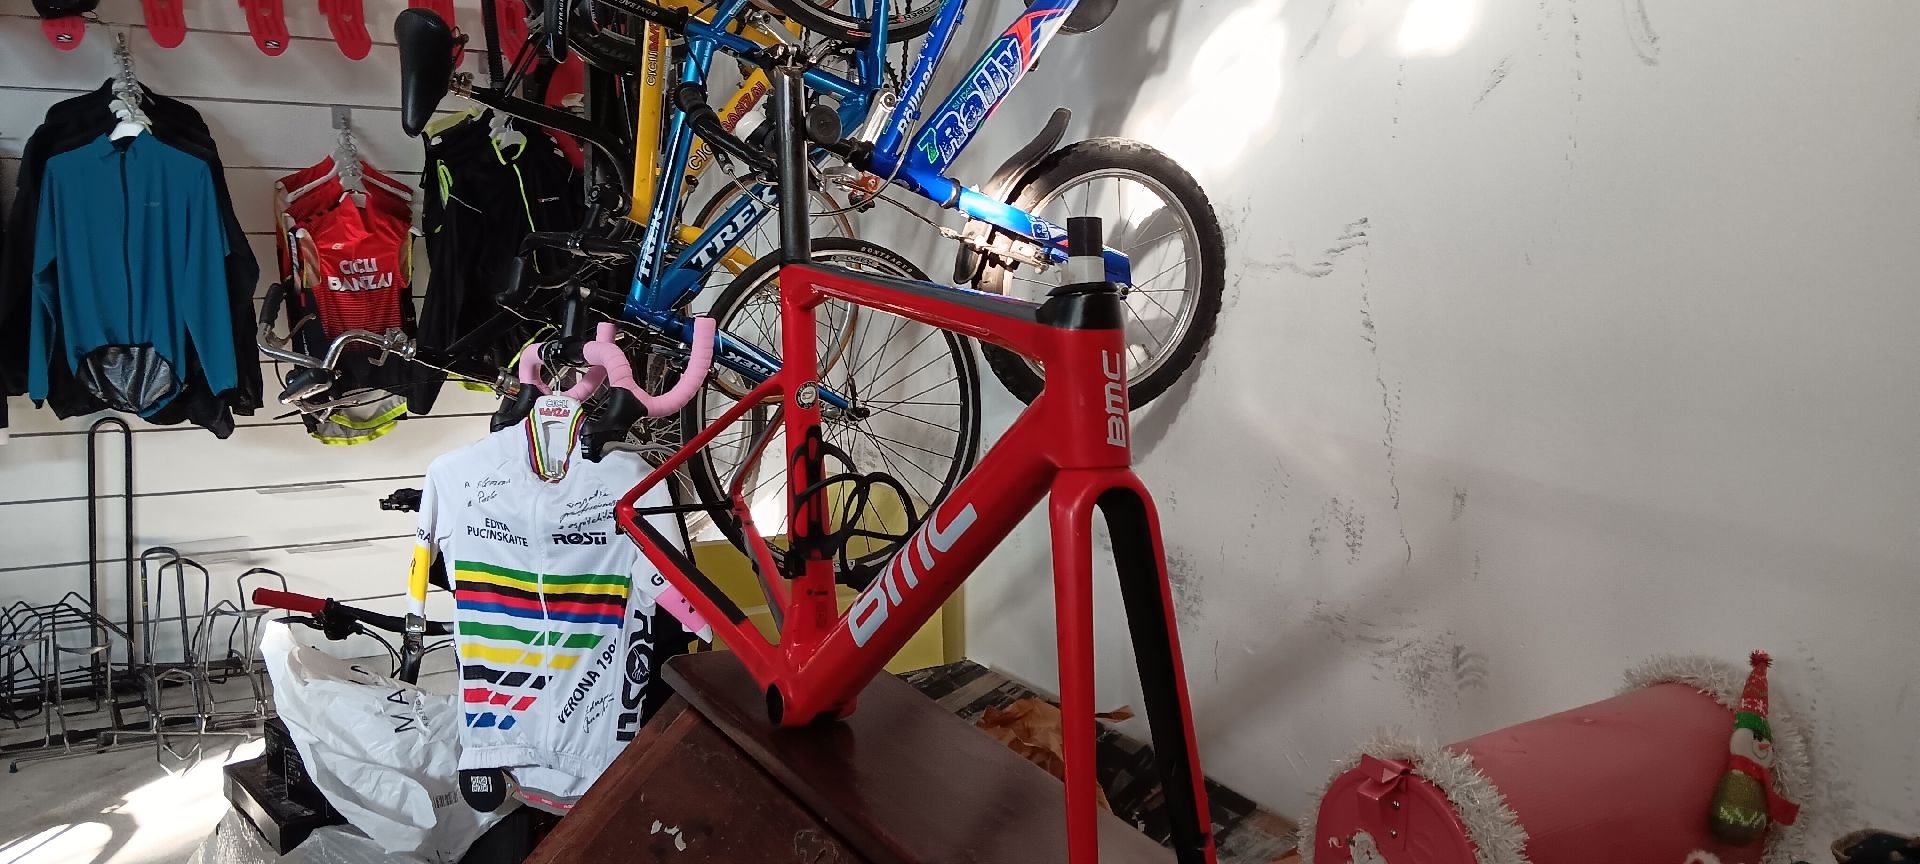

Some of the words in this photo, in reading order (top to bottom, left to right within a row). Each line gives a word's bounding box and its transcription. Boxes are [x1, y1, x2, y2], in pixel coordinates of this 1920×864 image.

[638, 207, 663, 280] TREK
[692, 186, 778, 269] TREK
[1101, 349, 1127, 448] BMC
[466, 525, 529, 547] PUCINSKAITE
[485, 517, 511, 532] EDITA
[847, 502, 979, 649] BMC
[557, 670, 601, 724] VERONA
